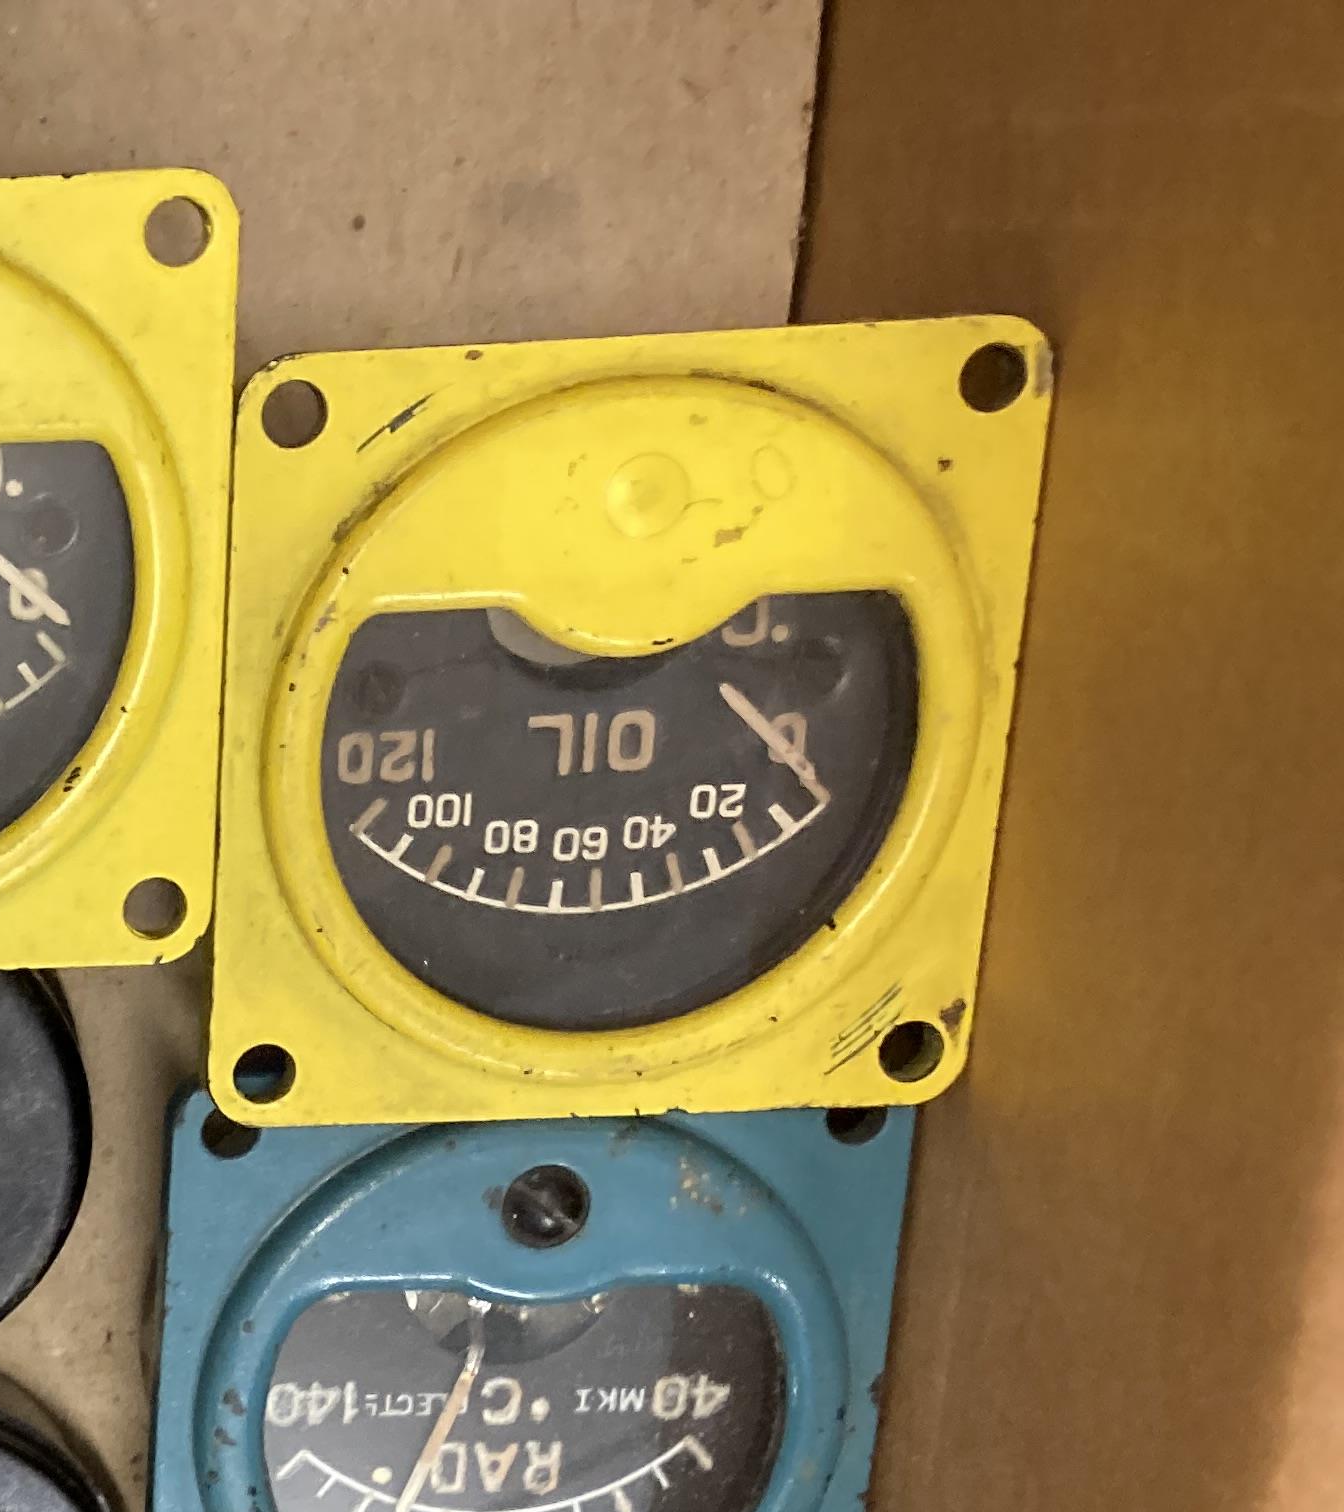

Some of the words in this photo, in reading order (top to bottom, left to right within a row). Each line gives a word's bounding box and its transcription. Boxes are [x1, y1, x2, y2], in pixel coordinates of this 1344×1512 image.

[337, 728, 435, 784] 120
[528, 709, 656, 776] OIL
[408, 793, 473, 829] 100
[690, 784, 746, 820] 20
[484, 819, 538, 855] 80
[553, 827, 608, 862] 60
[623, 815, 677, 850] 40
[265, 1381, 358, 1425] 140
[652, 1372, 731, 1421] 40
[430, 1440, 563, 1496] RAD
